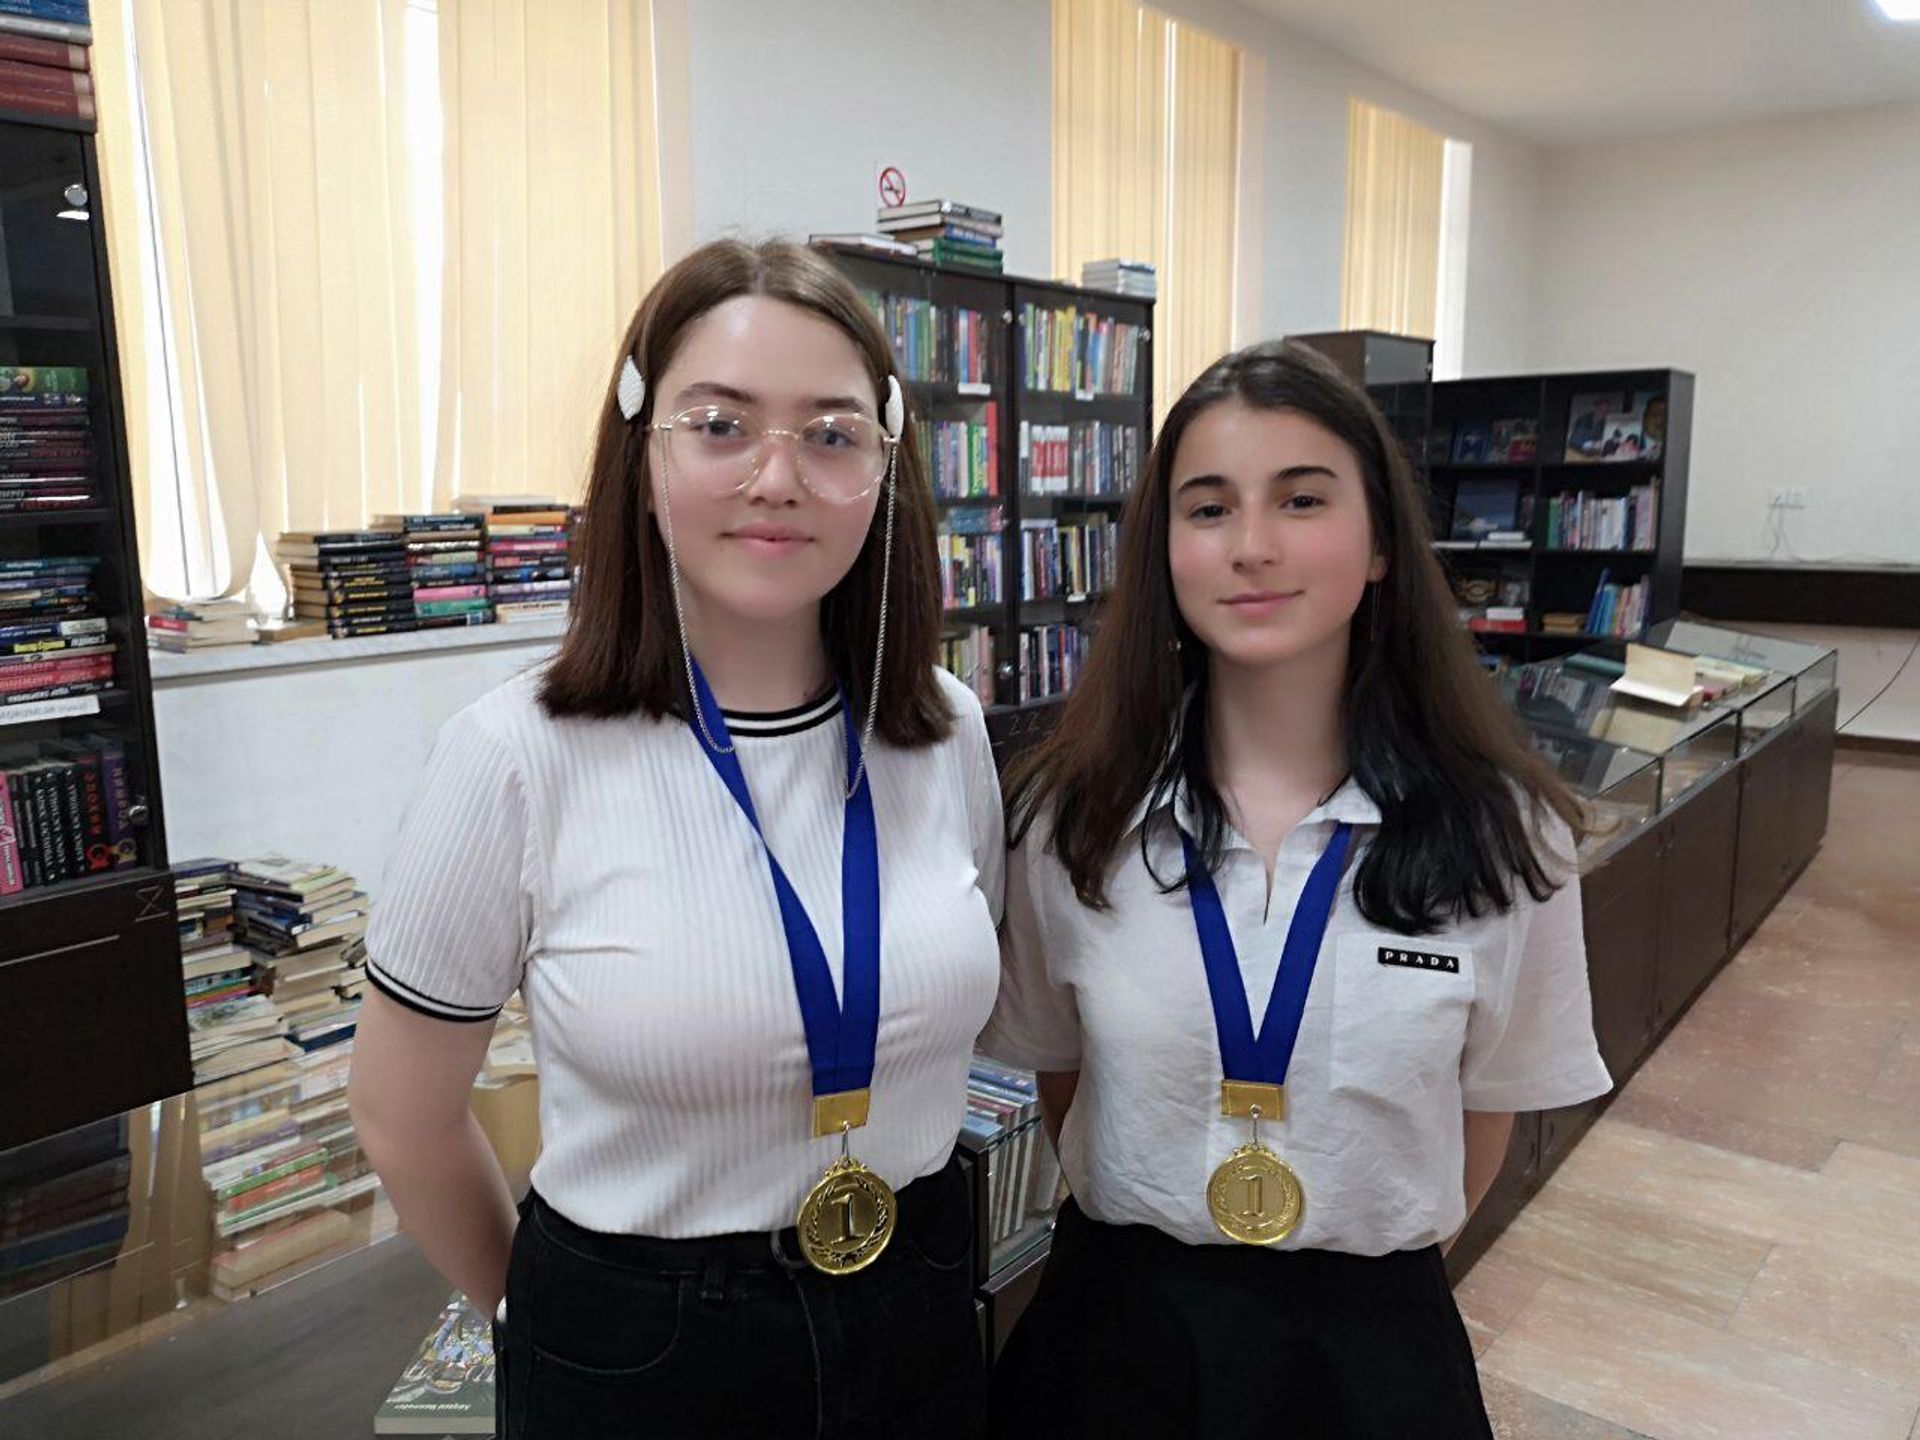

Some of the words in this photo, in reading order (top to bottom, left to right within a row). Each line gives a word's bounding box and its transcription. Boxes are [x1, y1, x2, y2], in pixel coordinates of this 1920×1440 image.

[1385, 950, 1454, 969] PRADA
[1240, 1174, 1266, 1217] 1
[830, 1192, 866, 1245] 1
